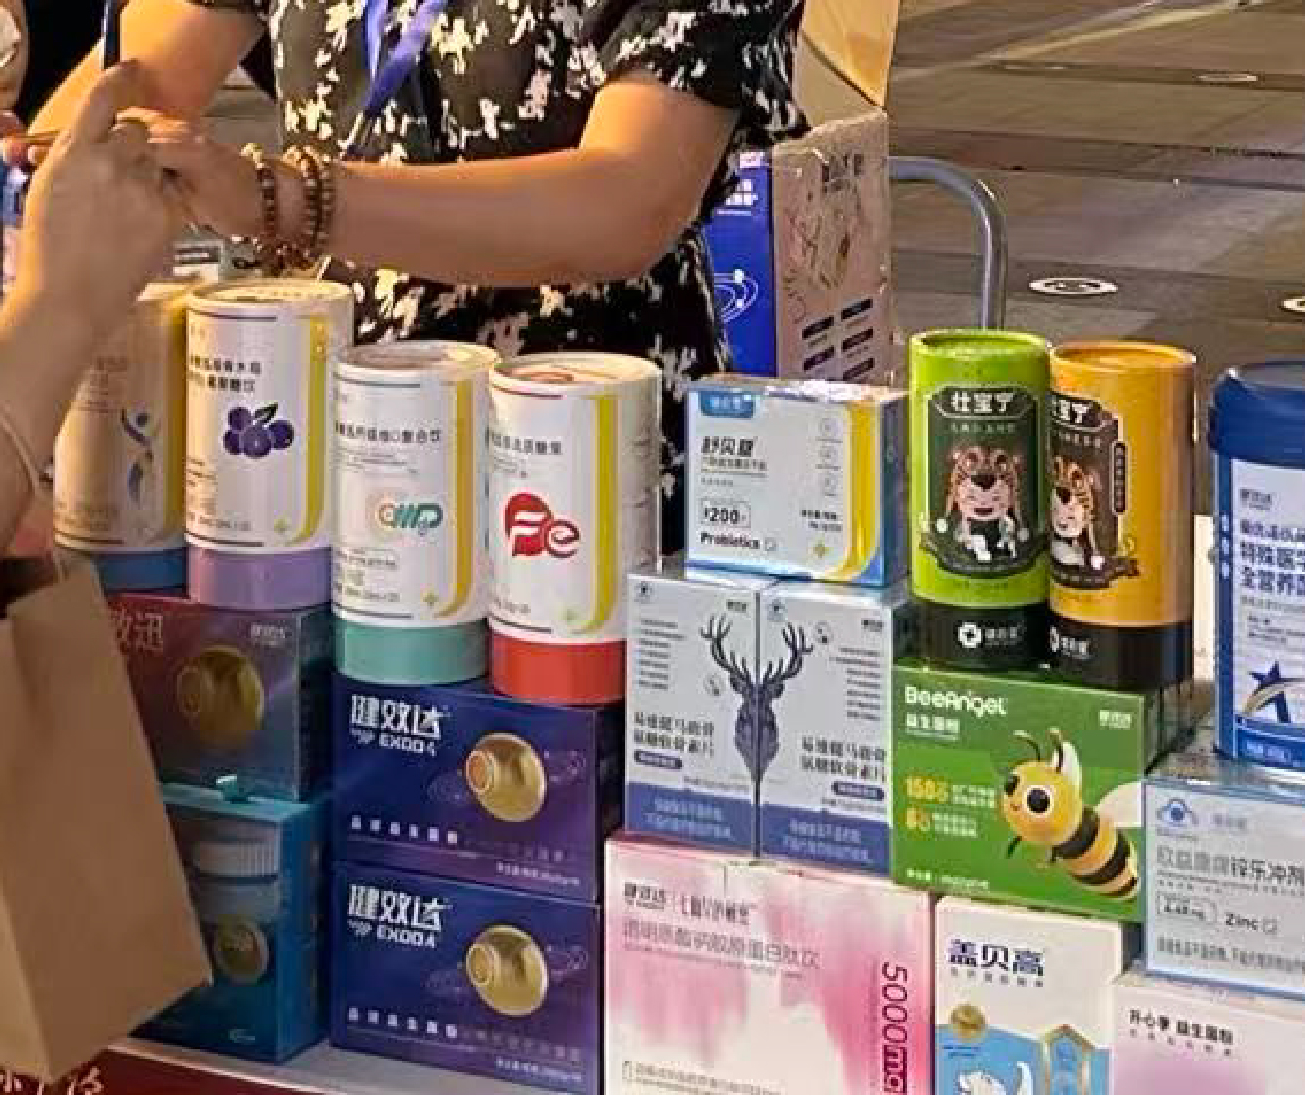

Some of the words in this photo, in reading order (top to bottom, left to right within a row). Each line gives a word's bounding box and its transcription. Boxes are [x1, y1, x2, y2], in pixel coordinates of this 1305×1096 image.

[504, 491, 581, 559] Fe
[350, 693, 449, 738] 健效达
[348, 883, 449, 933] 健效达
